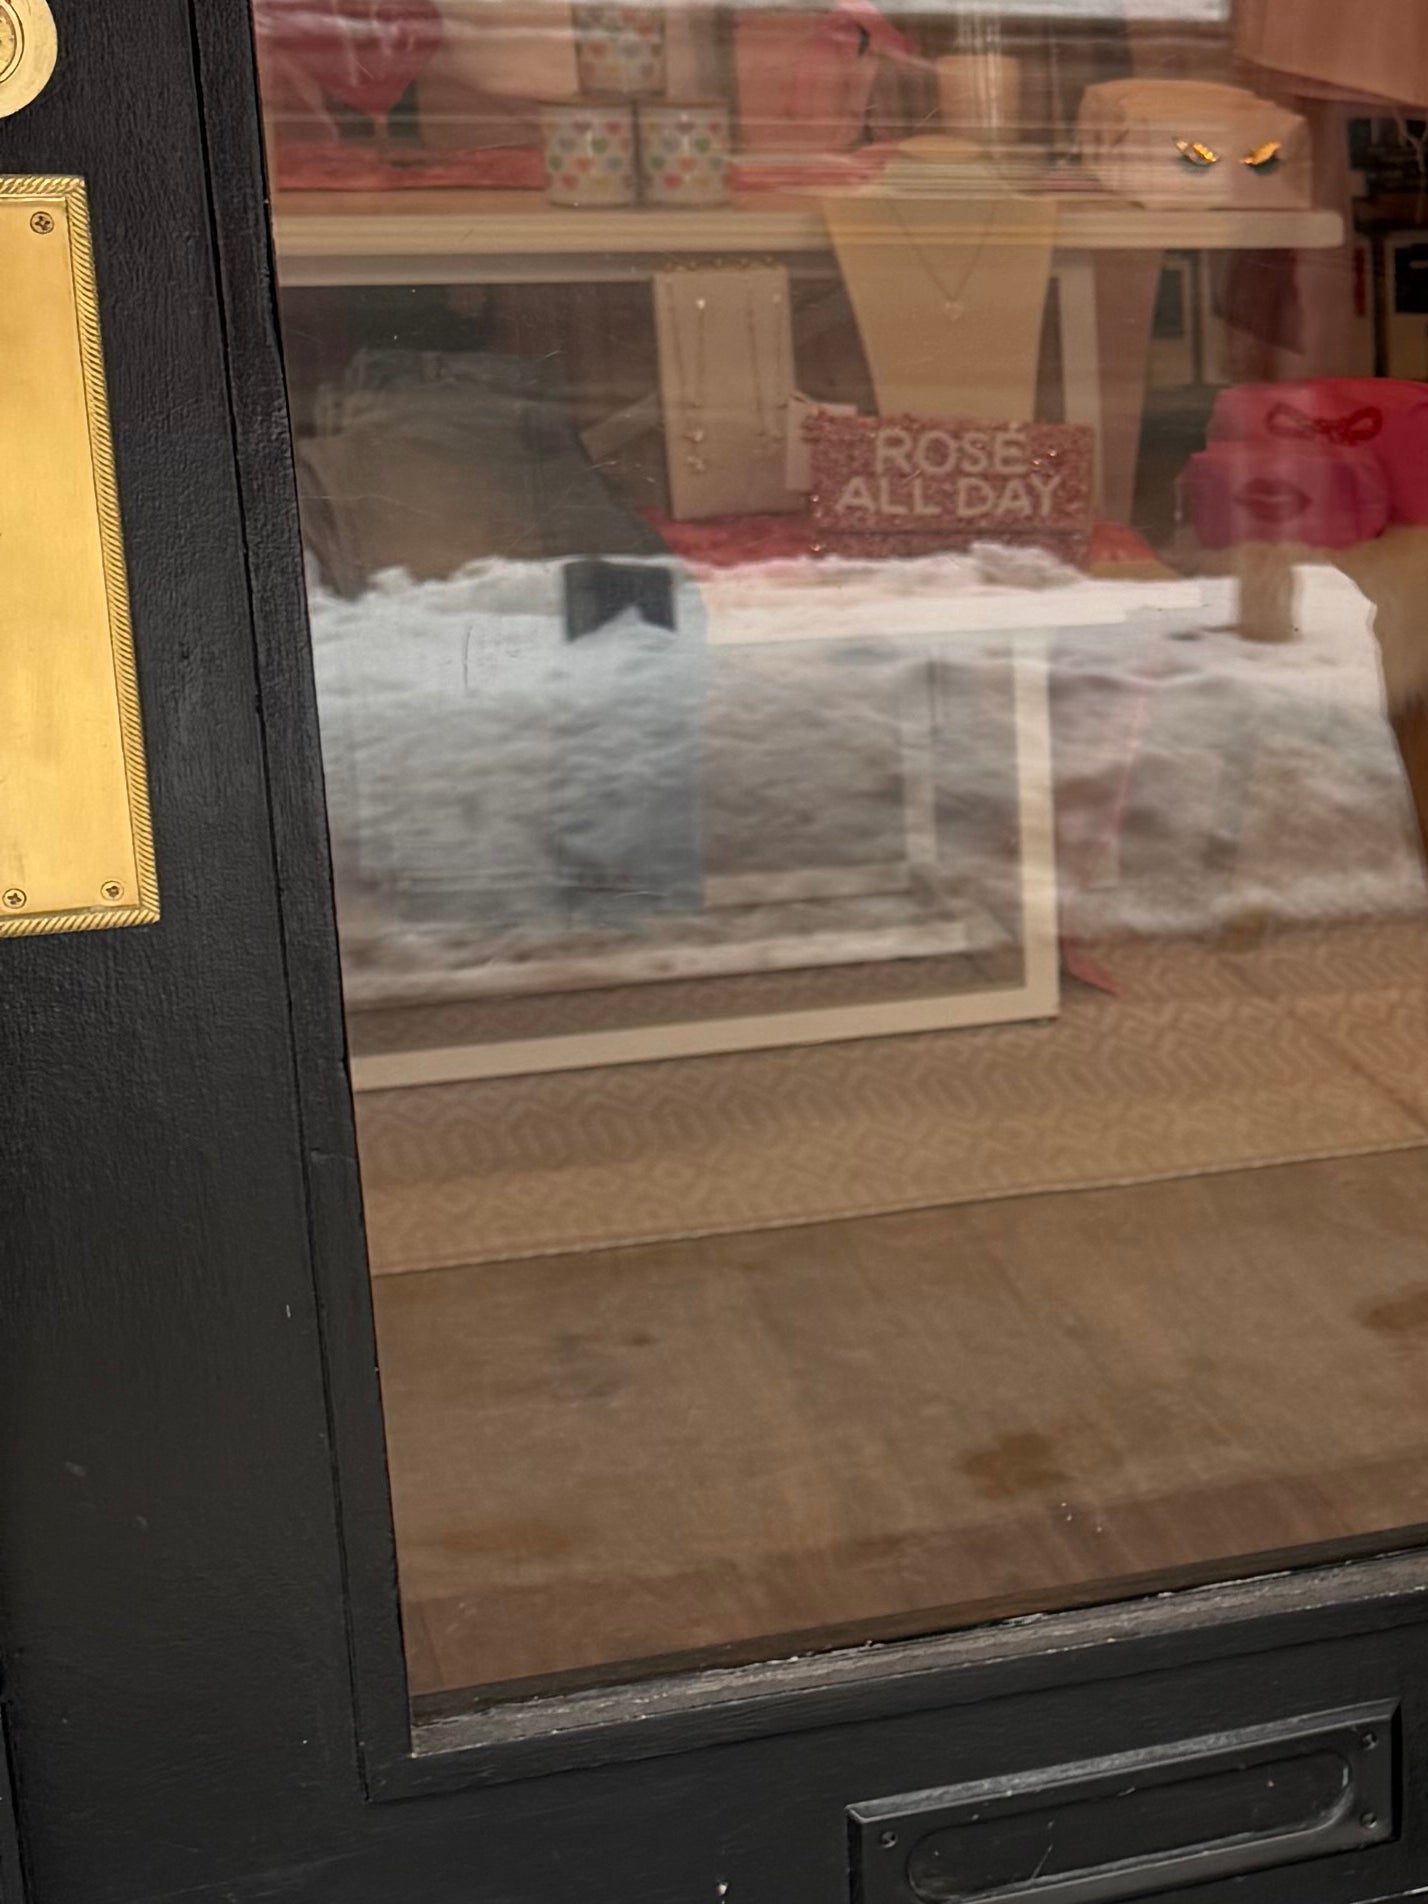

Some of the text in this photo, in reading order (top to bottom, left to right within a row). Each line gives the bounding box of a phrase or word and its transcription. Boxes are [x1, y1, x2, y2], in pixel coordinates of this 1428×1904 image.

[875, 421, 1032, 475] ROSÉ
[835, 475, 1063, 518] ALL DAY
